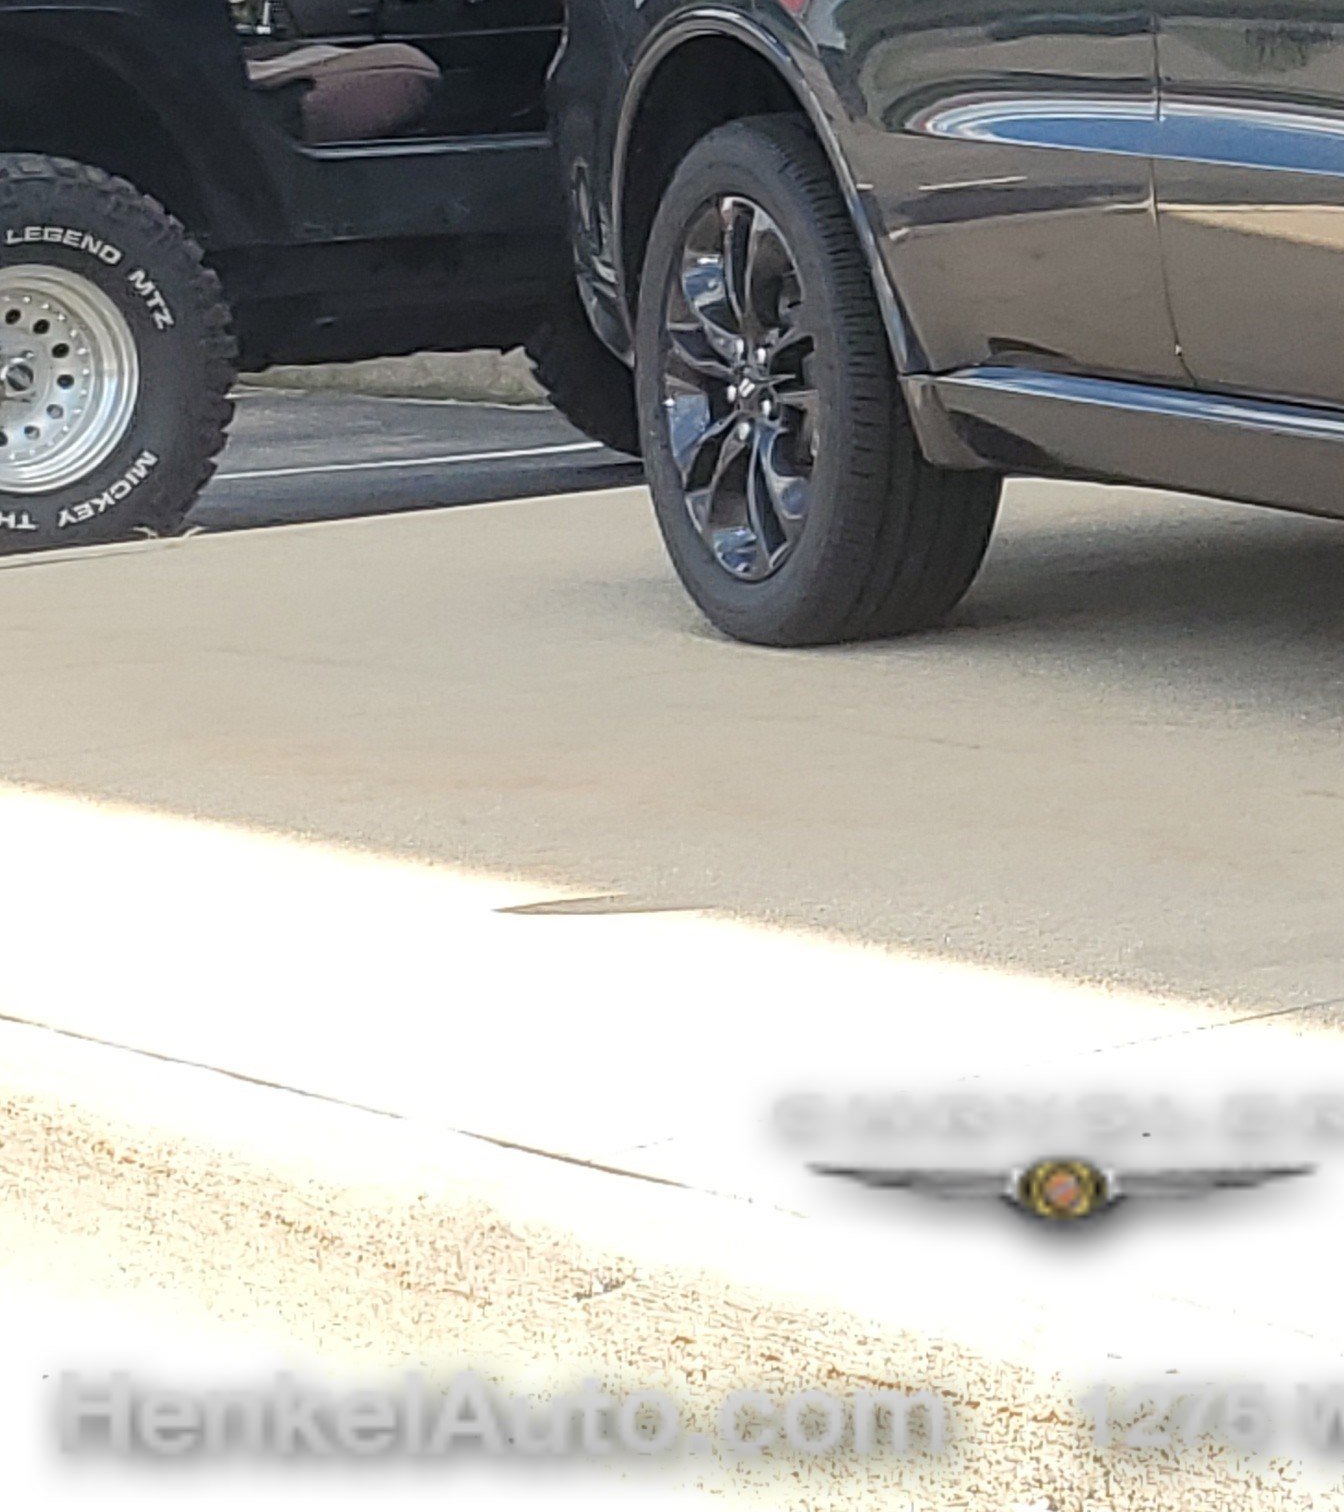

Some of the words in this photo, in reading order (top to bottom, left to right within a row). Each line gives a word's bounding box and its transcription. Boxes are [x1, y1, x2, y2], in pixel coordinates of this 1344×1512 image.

[5, 226, 123, 265] LEGEND
[127, 269, 175, 330] MTZ
[57, 450, 159, 528] MICKEY
